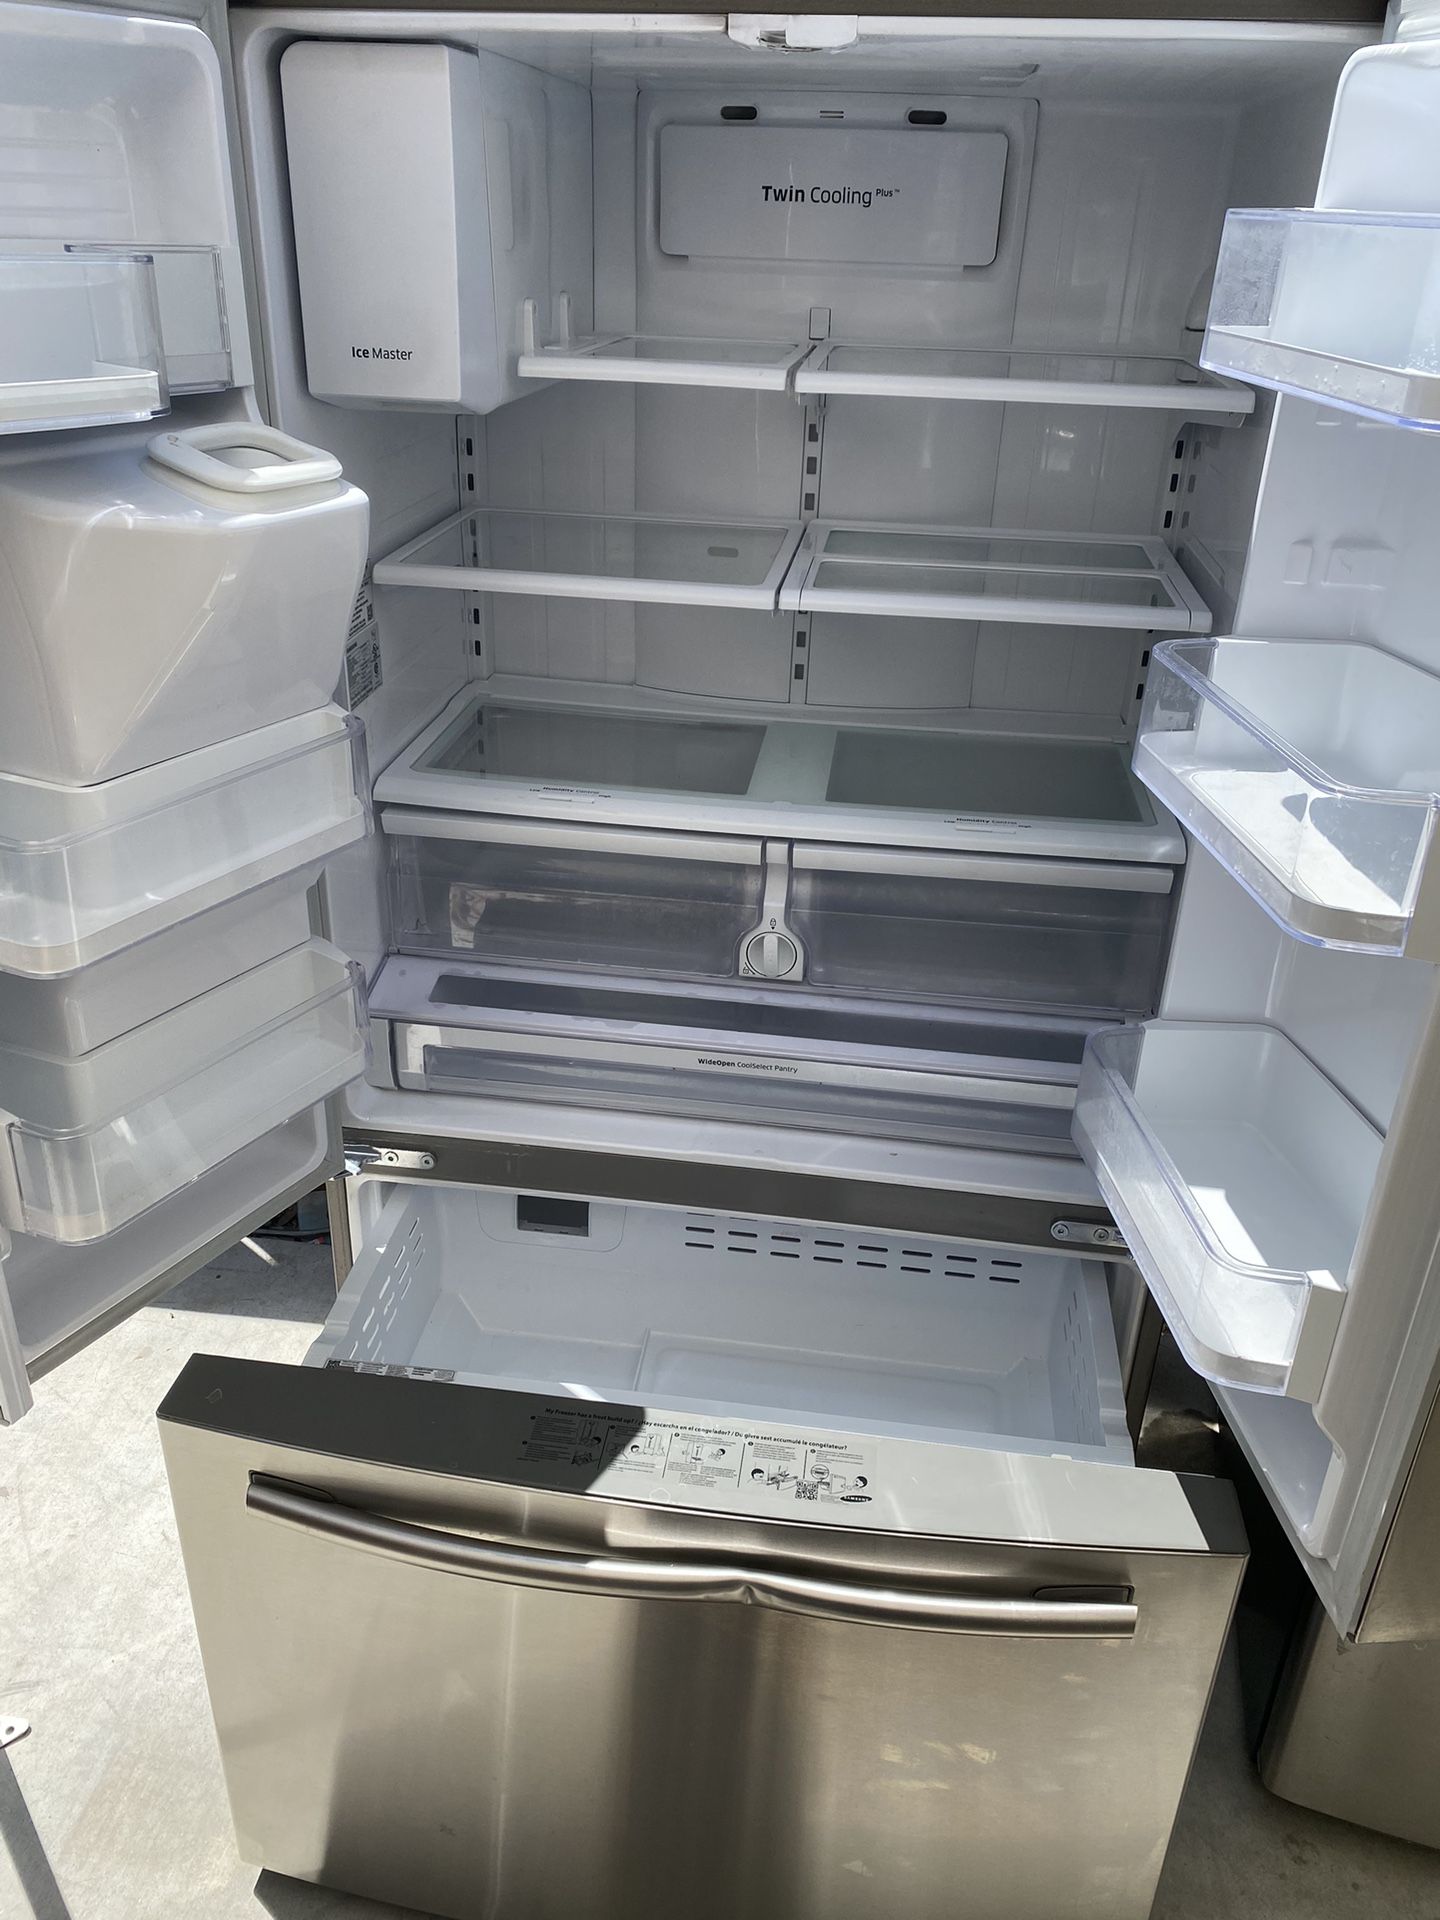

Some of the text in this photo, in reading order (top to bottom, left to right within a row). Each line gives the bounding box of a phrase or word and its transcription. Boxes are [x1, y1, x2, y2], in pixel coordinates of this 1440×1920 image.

[761, 185, 806, 203] Twin
[810, 186, 873, 208] Cooling
[351, 346, 413, 361] Ice Master
[697, 1058, 799, 1074] WideOpen CoolSelect Pantry
